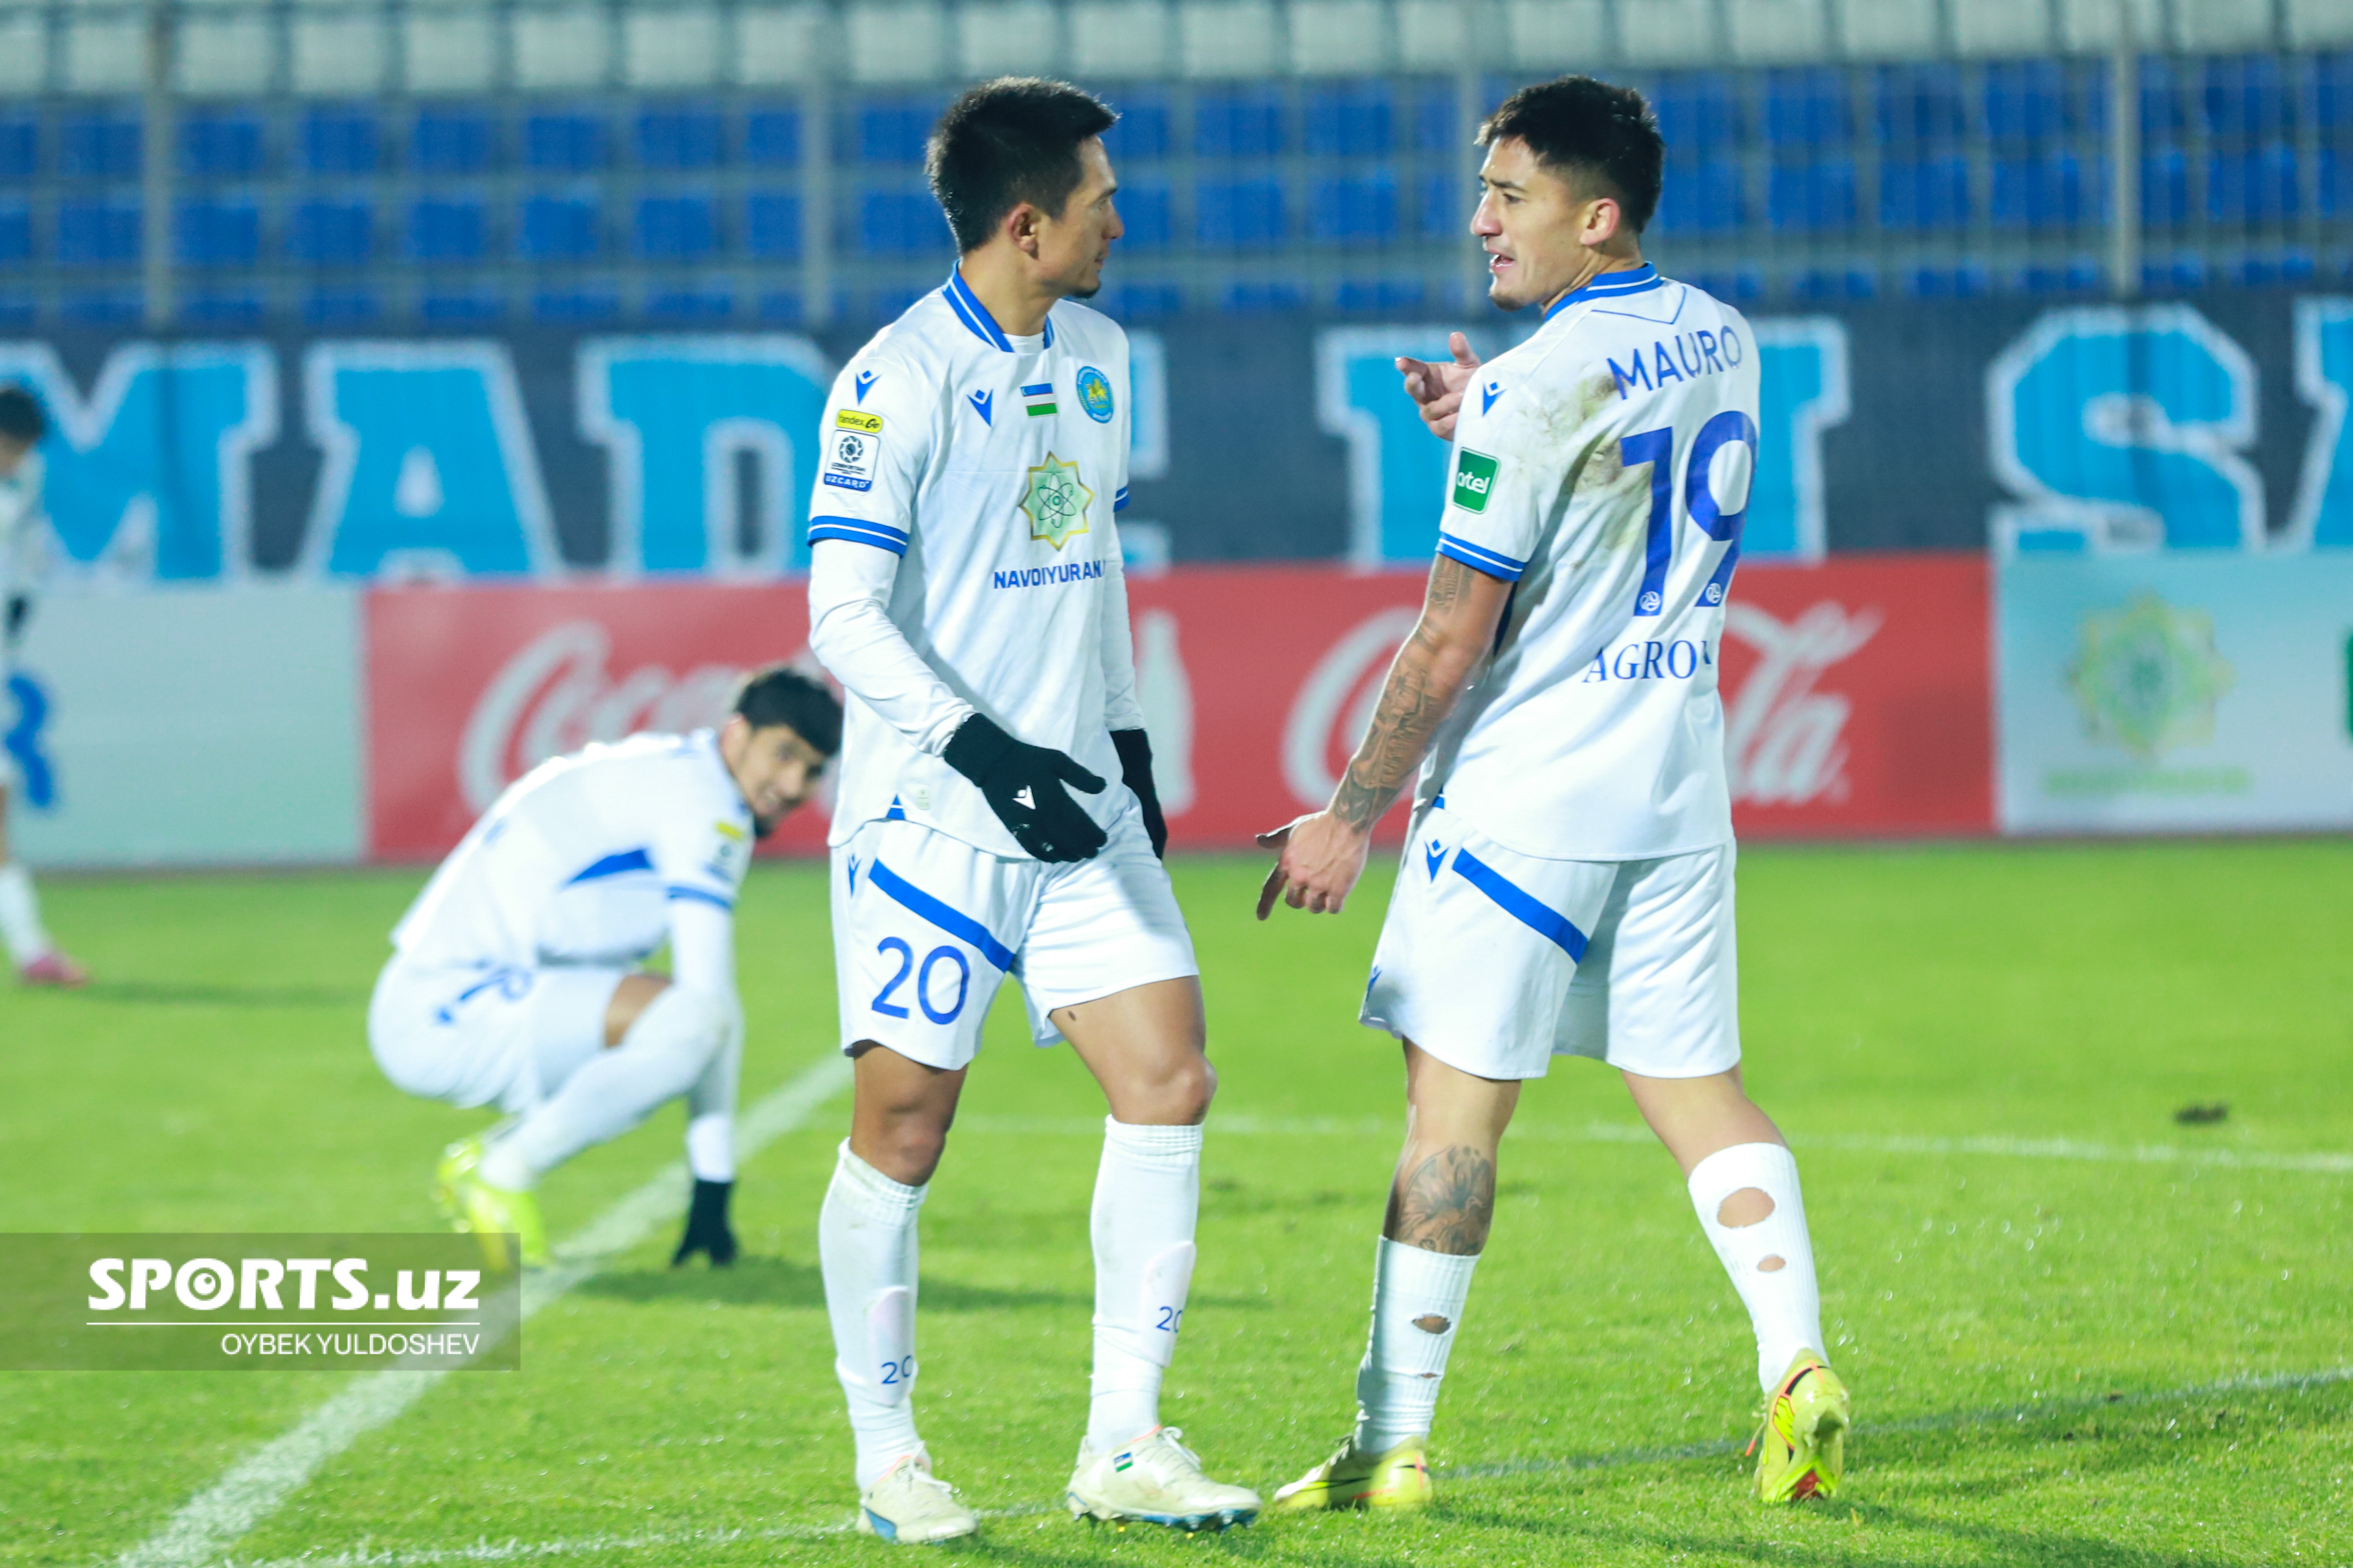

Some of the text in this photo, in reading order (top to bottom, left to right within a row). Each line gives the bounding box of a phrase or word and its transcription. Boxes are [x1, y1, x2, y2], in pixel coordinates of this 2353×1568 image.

[1607, 325, 1742, 400] MAURO
[865, 418, 880, 429] Go
[1620, 410, 1758, 616] 19
[871, 936, 970, 1025] 20
